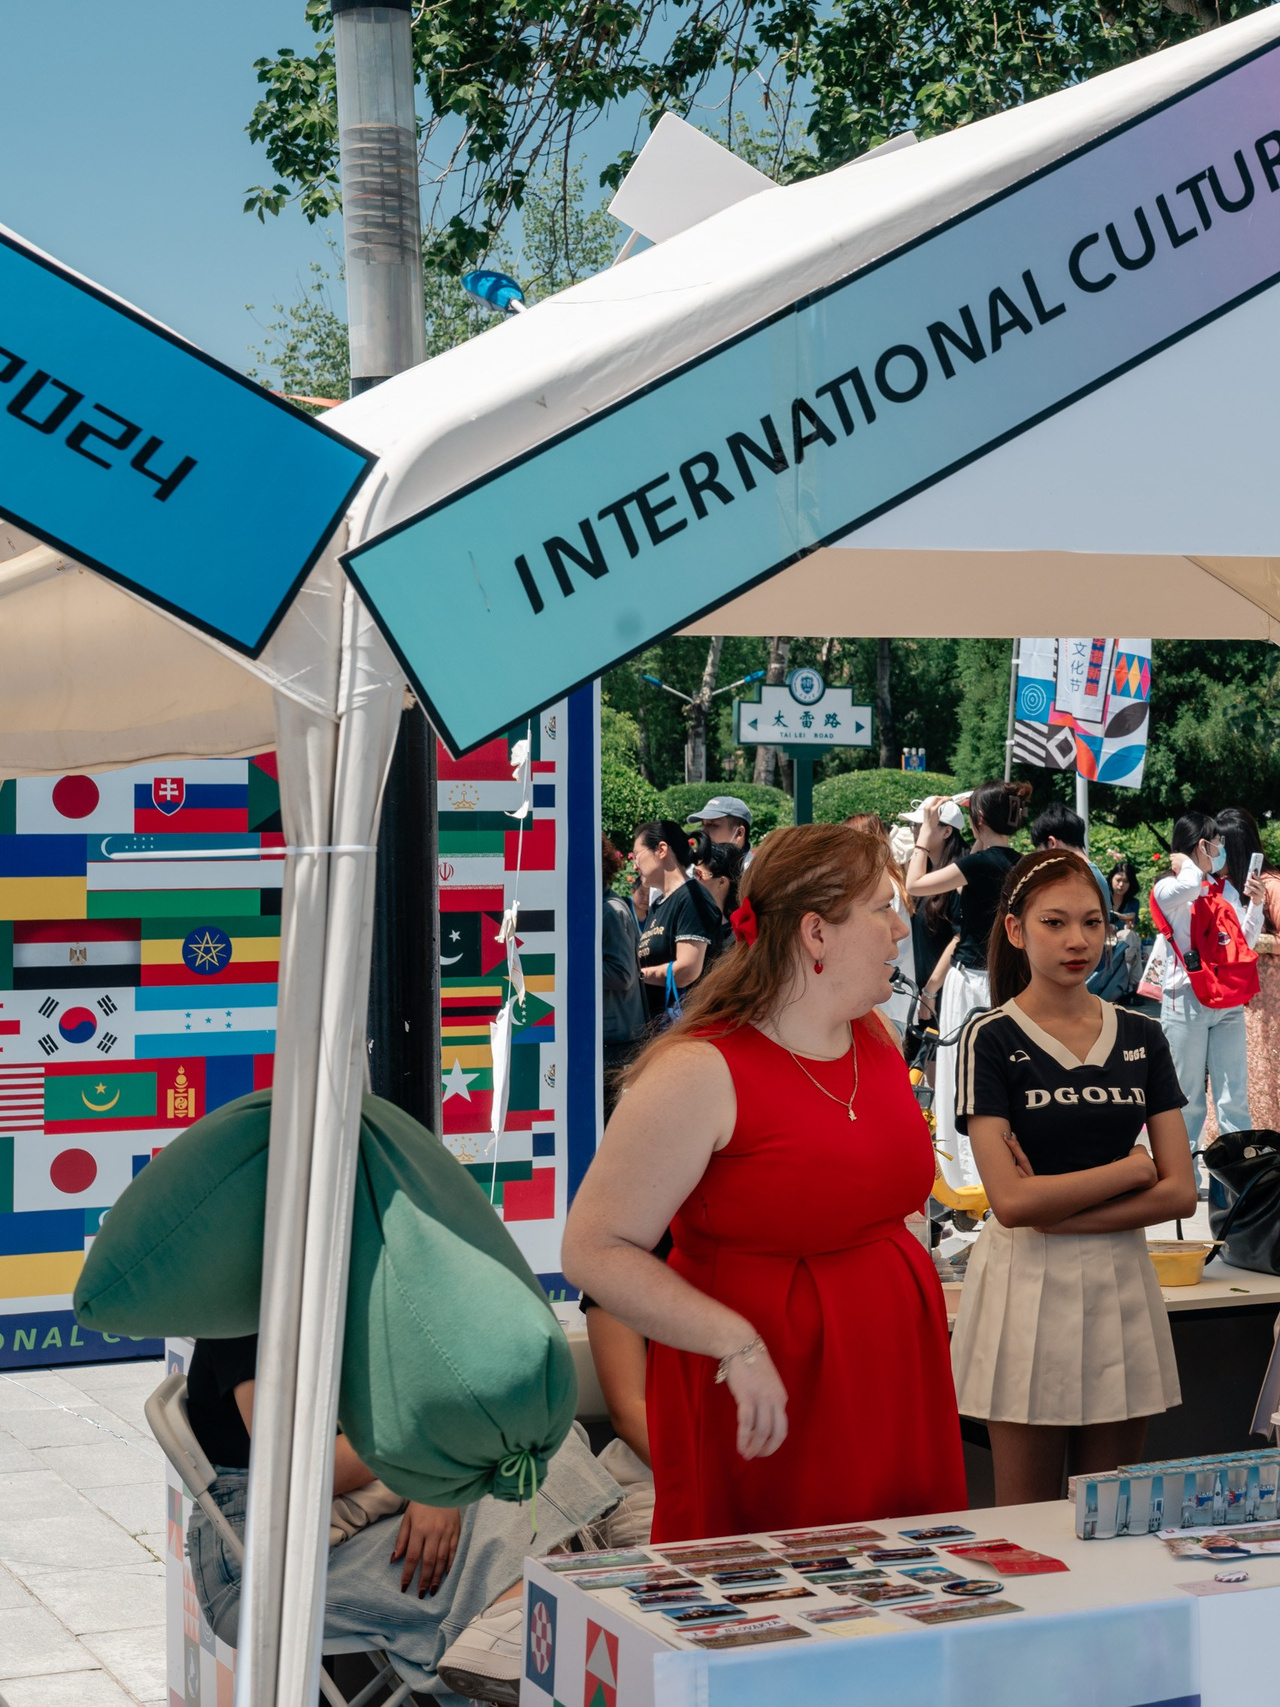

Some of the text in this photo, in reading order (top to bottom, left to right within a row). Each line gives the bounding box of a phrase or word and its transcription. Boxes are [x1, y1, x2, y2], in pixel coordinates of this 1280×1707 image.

[514, 269, 1067, 615] INTERNATIONAL
[1070, 641, 1088, 693] 文化节
[771, 709, 842, 729] 太雷路
[1024, 1086, 1146, 1110] DGOLD
[0, 1325, 84, 1351] NAL
